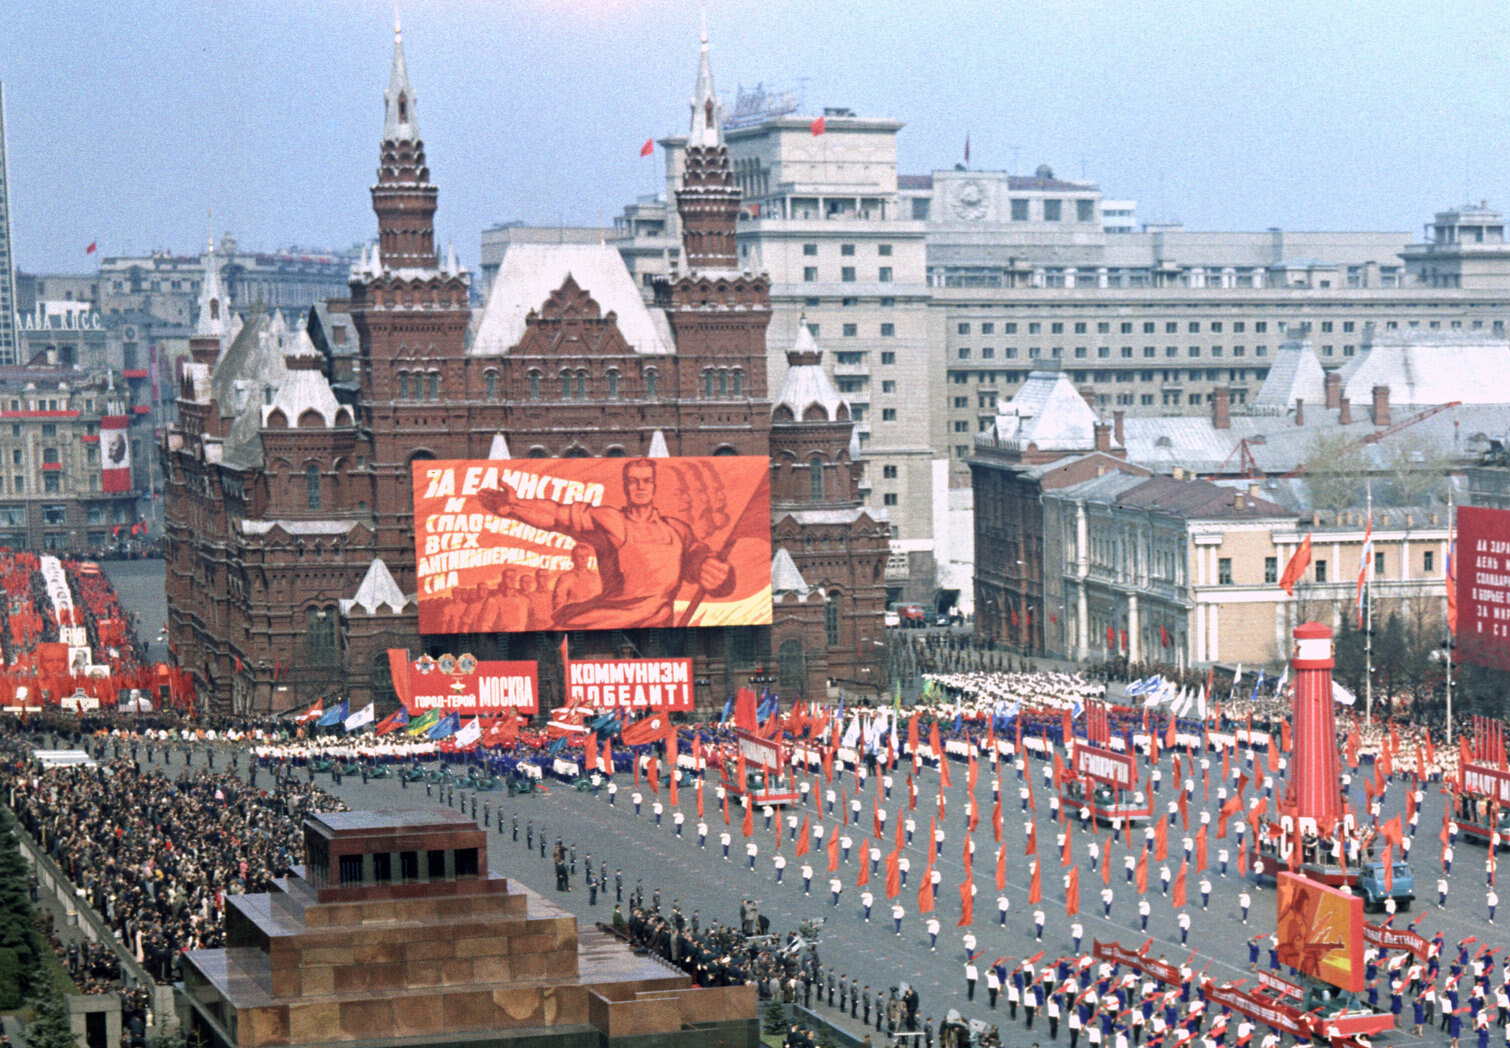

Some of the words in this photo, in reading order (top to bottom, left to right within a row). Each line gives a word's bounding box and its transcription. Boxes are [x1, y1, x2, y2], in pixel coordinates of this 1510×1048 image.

[424, 468, 455, 498] ЗА
[445, 497, 466, 513] И
[425, 513, 577, 550] СПЛОЧЕННОСТЬ
[425, 532, 480, 555] ВСЕХ
[1476, 539, 1487, 551] ДА
[1476, 556, 1498, 570] ДЕНЬ
[424, 571, 459, 594] СИЛ
[1477, 605, 1488, 617] ЗА
[570, 662, 688, 684] КОММУНИЗМ
[415, 693, 476, 709] ГОРОД-ГЕРОЙ
[479, 676, 533, 707] МОСКВА
